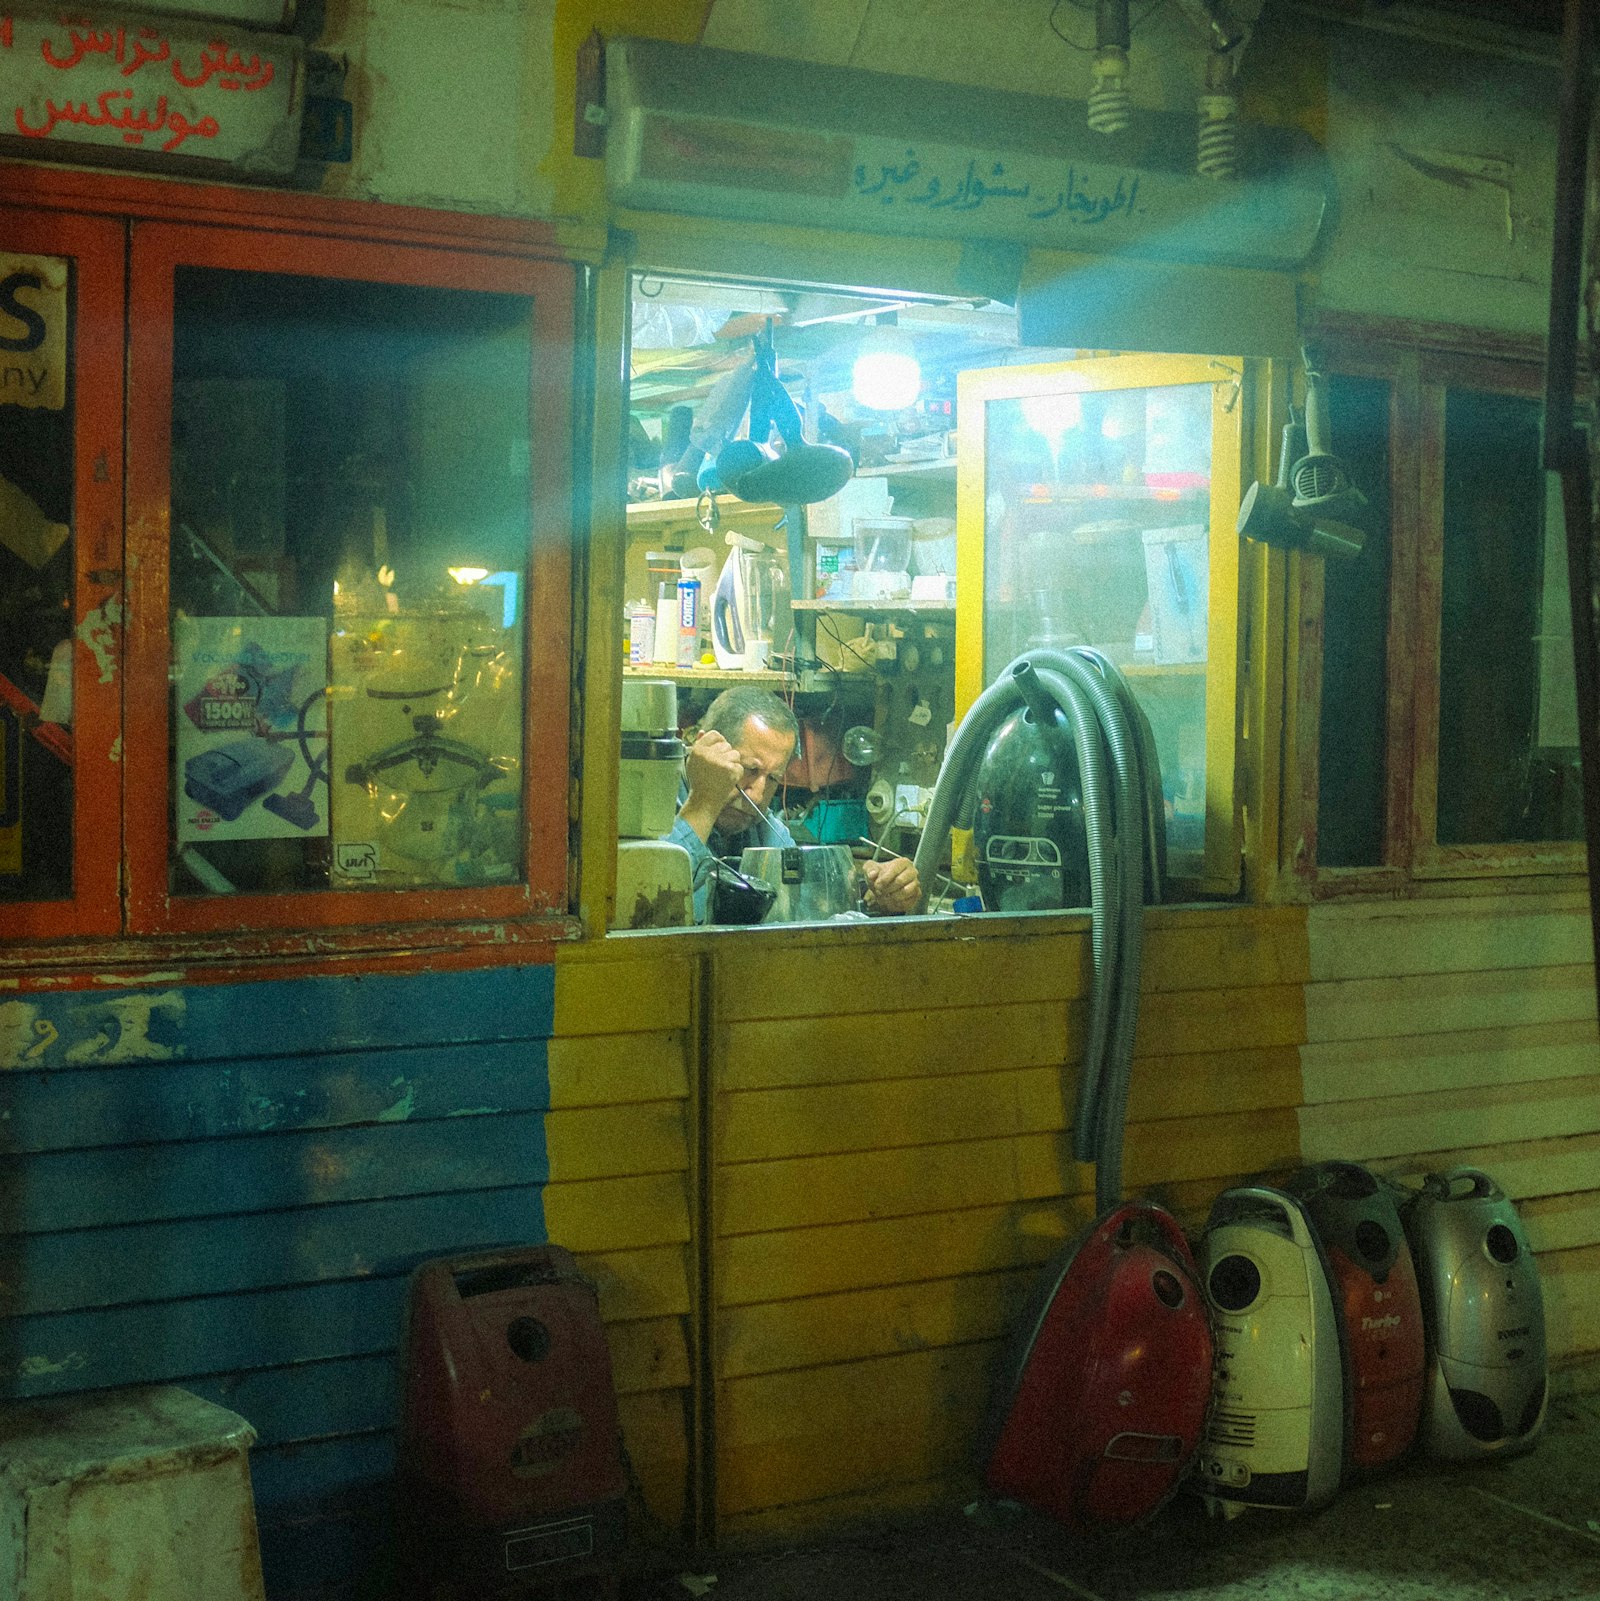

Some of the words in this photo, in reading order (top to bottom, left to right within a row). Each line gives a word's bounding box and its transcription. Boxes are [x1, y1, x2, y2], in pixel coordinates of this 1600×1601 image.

[41, 14, 171, 76] تراش
[172, 35, 274, 91] ریش
[15, 89, 220, 152] مولینکس
[1361, 1313, 1401, 1331] Turbo
